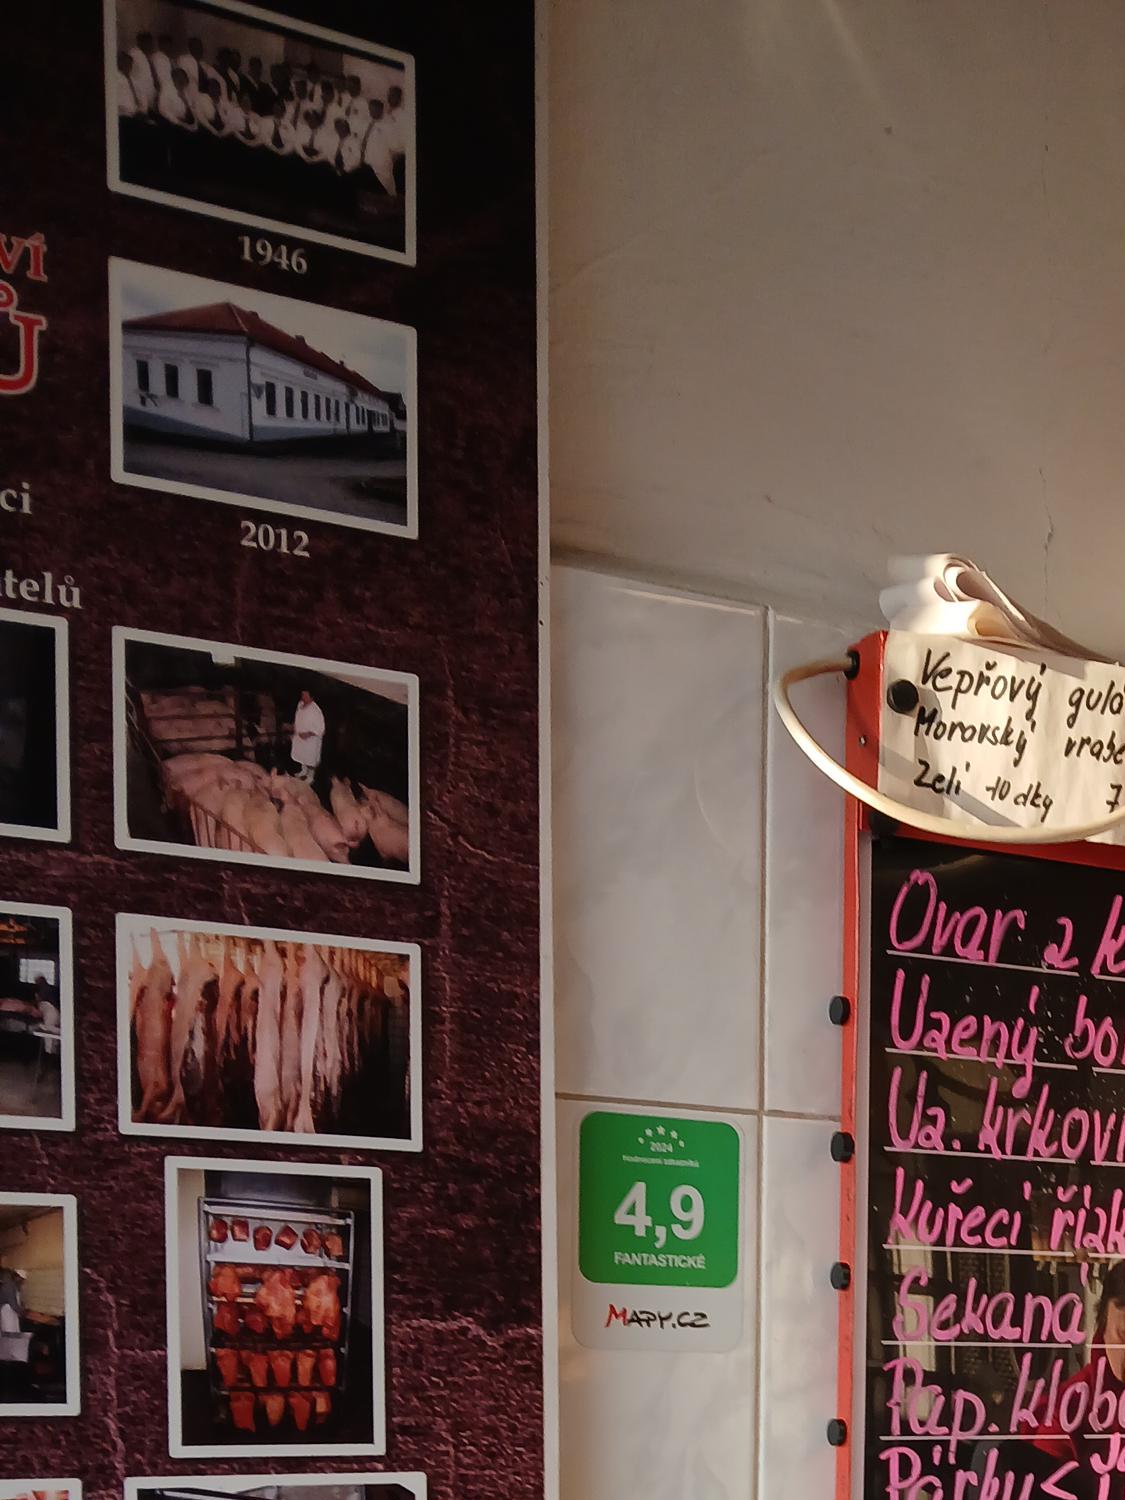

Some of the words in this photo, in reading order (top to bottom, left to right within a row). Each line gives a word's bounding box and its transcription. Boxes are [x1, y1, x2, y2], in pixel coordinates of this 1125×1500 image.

[238, 236, 308, 275] 1946
[240, 520, 310, 558] 2012
[0, 569, 84, 609] telů
[921, 648, 1047, 720] Vepřový
[889, 869, 1026, 963] Ovar
[890, 968, 1039, 1099] Uzený
[613, 1181, 705, 1249] 4,9
[887, 1167, 1032, 1249] Kuřecí
[613, 1251, 706, 1270] FANTASTICKÉ
[892, 1262, 1088, 1345] Sekaná
[882, 1357, 1000, 1464] Pap.
